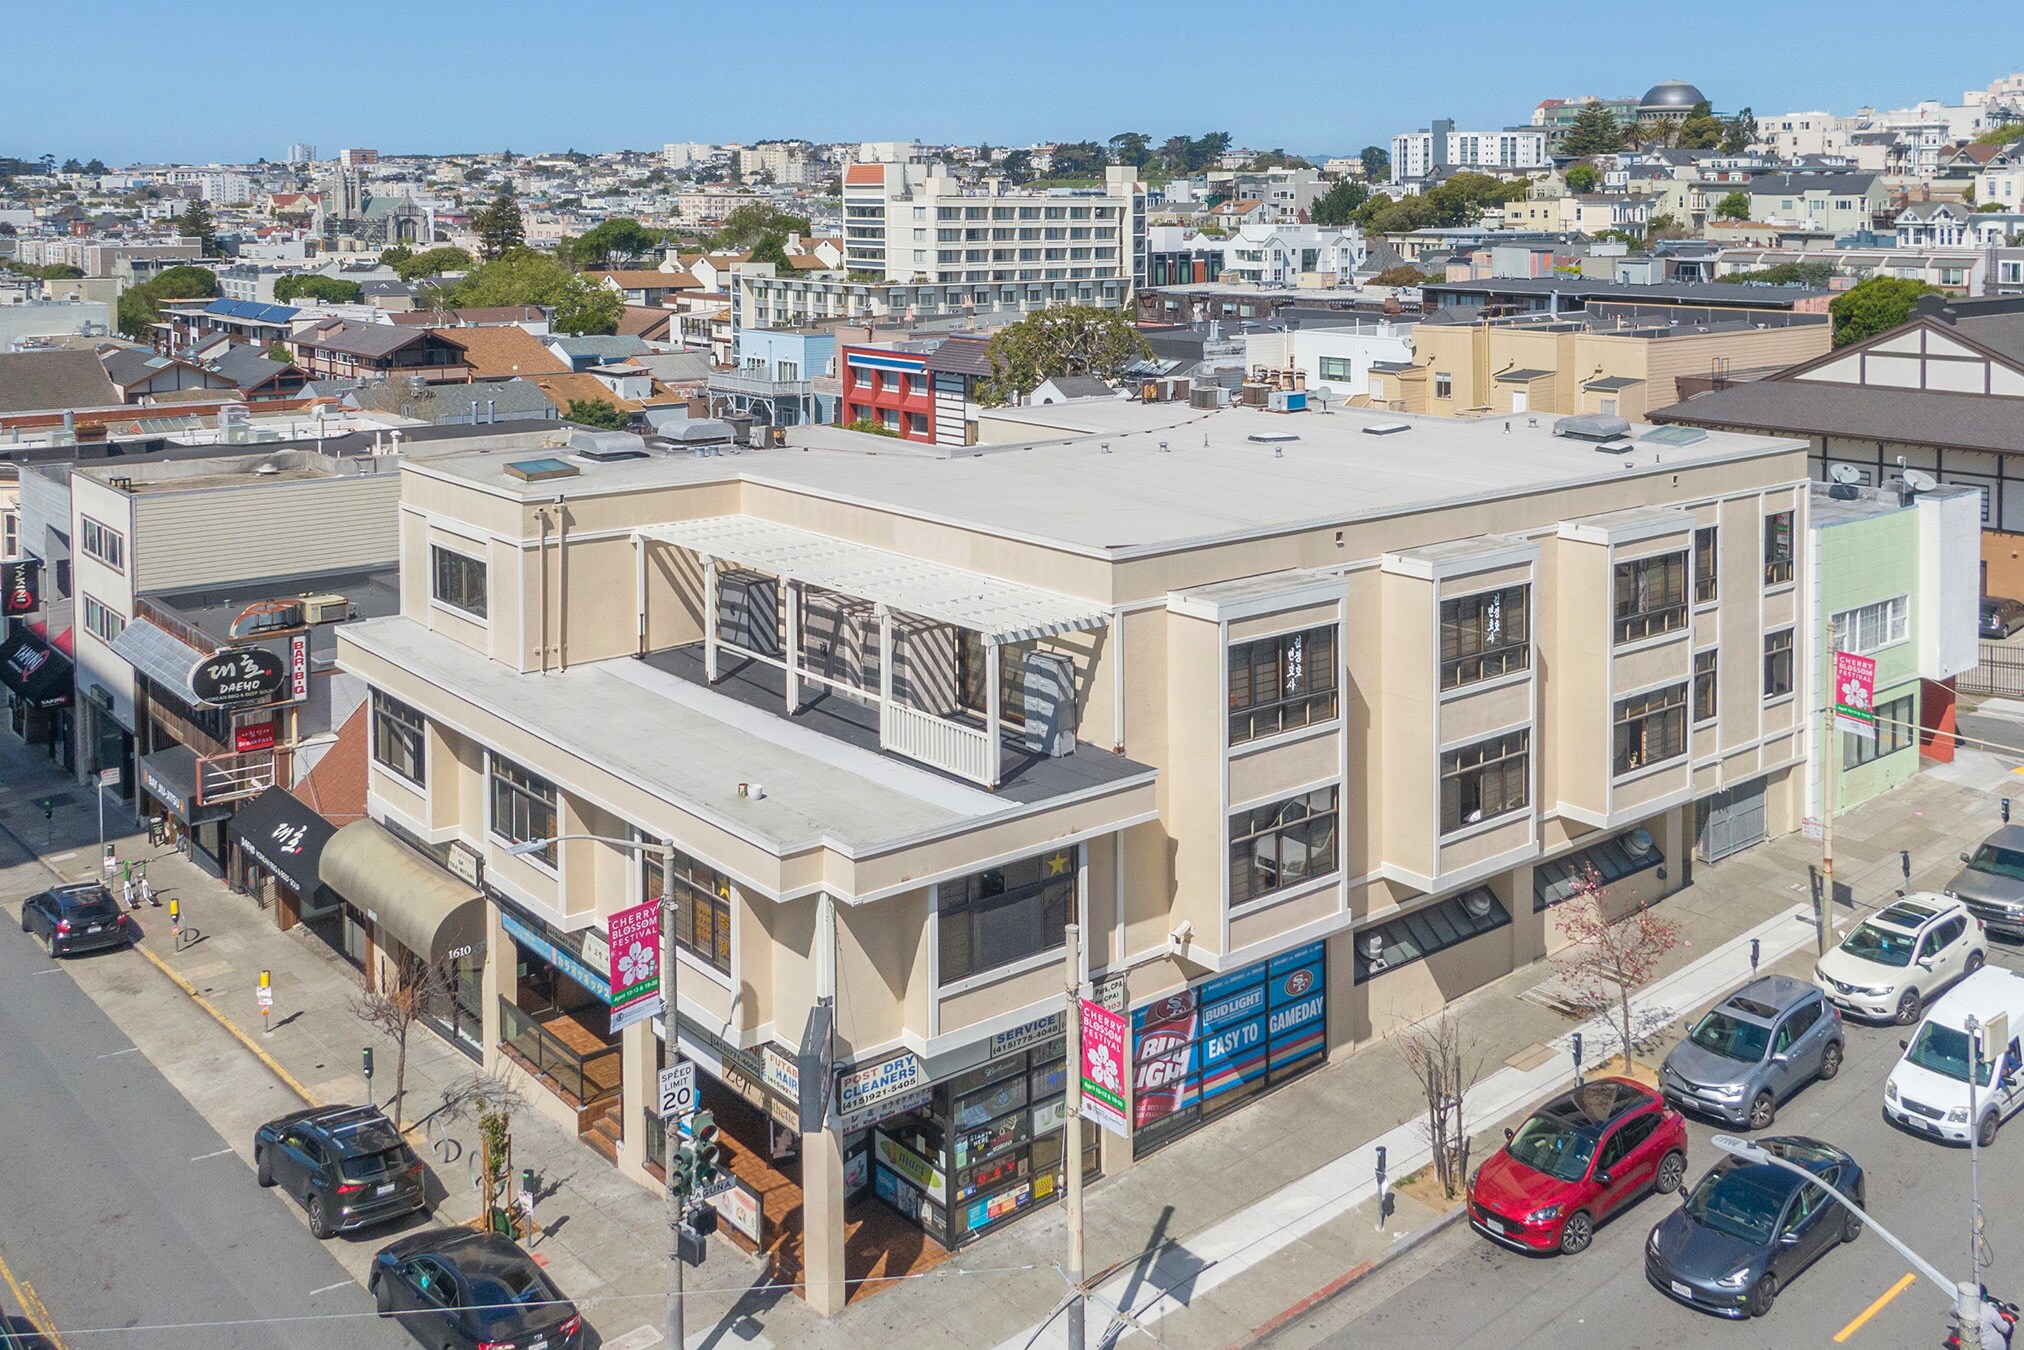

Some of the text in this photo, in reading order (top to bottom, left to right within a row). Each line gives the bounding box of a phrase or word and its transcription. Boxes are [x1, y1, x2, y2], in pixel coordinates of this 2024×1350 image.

[1838, 662, 1873, 677] BLOSSOM
[1839, 656, 1873, 670] CHERRY
[219, 680, 260, 694] DAEHO
[1838, 669, 1871, 683] FESTIVAL
[612, 906, 656, 930] CHERRY
[612, 915, 658, 940] BLOSSOM
[612, 928, 658, 949] FESTIVAL
[448, 945, 472, 960] 1610
[1110, 980, 1123, 991] CPA
[614, 993, 626, 1003] April
[1204, 1004, 1230, 1023] BUD
[1228, 990, 1262, 1012] LIGHT
[1083, 1007, 1122, 1033] CHERRY
[1268, 996, 1324, 1034] GAMEDAY
[992, 1024, 1059, 1055] (415)775-4048
[996, 1014, 1057, 1045] SERVICE
[1083, 1016, 1122, 1044] BLOSSOM
[1083, 1026, 1121, 1053] FESTIVAL
[1208, 1022, 1259, 1060] EASY TO
[661, 1066, 692, 1083] SPEED
[769, 1054, 799, 1079] FUTAB
[844, 1055, 914, 1088] POST DRY
[664, 1077, 688, 1092] LIMIT
[775, 1067, 799, 1091] HAIR
[843, 1065, 916, 1101] CLEANERS
[663, 1087, 690, 1111] 20
[843, 1077, 916, 1112] (415)921-5405
[694, 1180, 732, 1201] AGUNA
